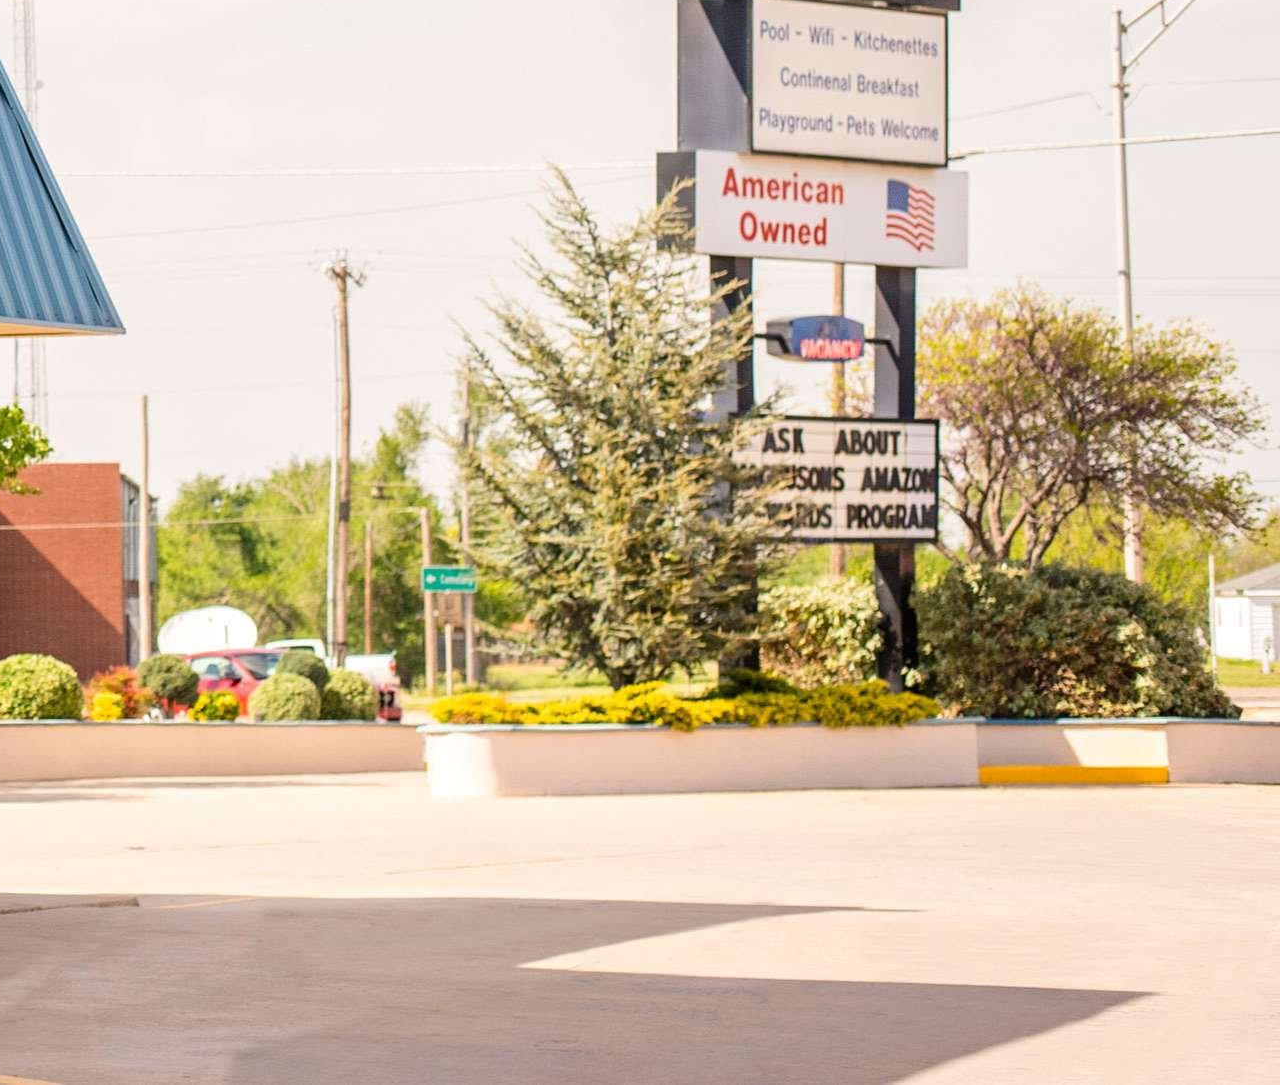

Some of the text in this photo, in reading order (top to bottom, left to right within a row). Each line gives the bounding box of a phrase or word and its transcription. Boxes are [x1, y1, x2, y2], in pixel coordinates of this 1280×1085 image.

[760, 20, 789, 41] Pool
[809, 24, 834, 46] Wifi
[854, 29, 938, 57] Kitchenettes
[780, 66, 919, 97] Continenal Breakfast
[759, 108, 832, 133] Playground
[847, 115, 875, 136] Pets
[881, 118, 939, 141] Welcome
[722, 167, 844, 205] American
[739, 212, 827, 246] Owned
[763, 428, 901, 455] ASK ABOUT
[862, 467, 935, 492] AMAZON
[847, 503, 935, 529] PROGRAM
